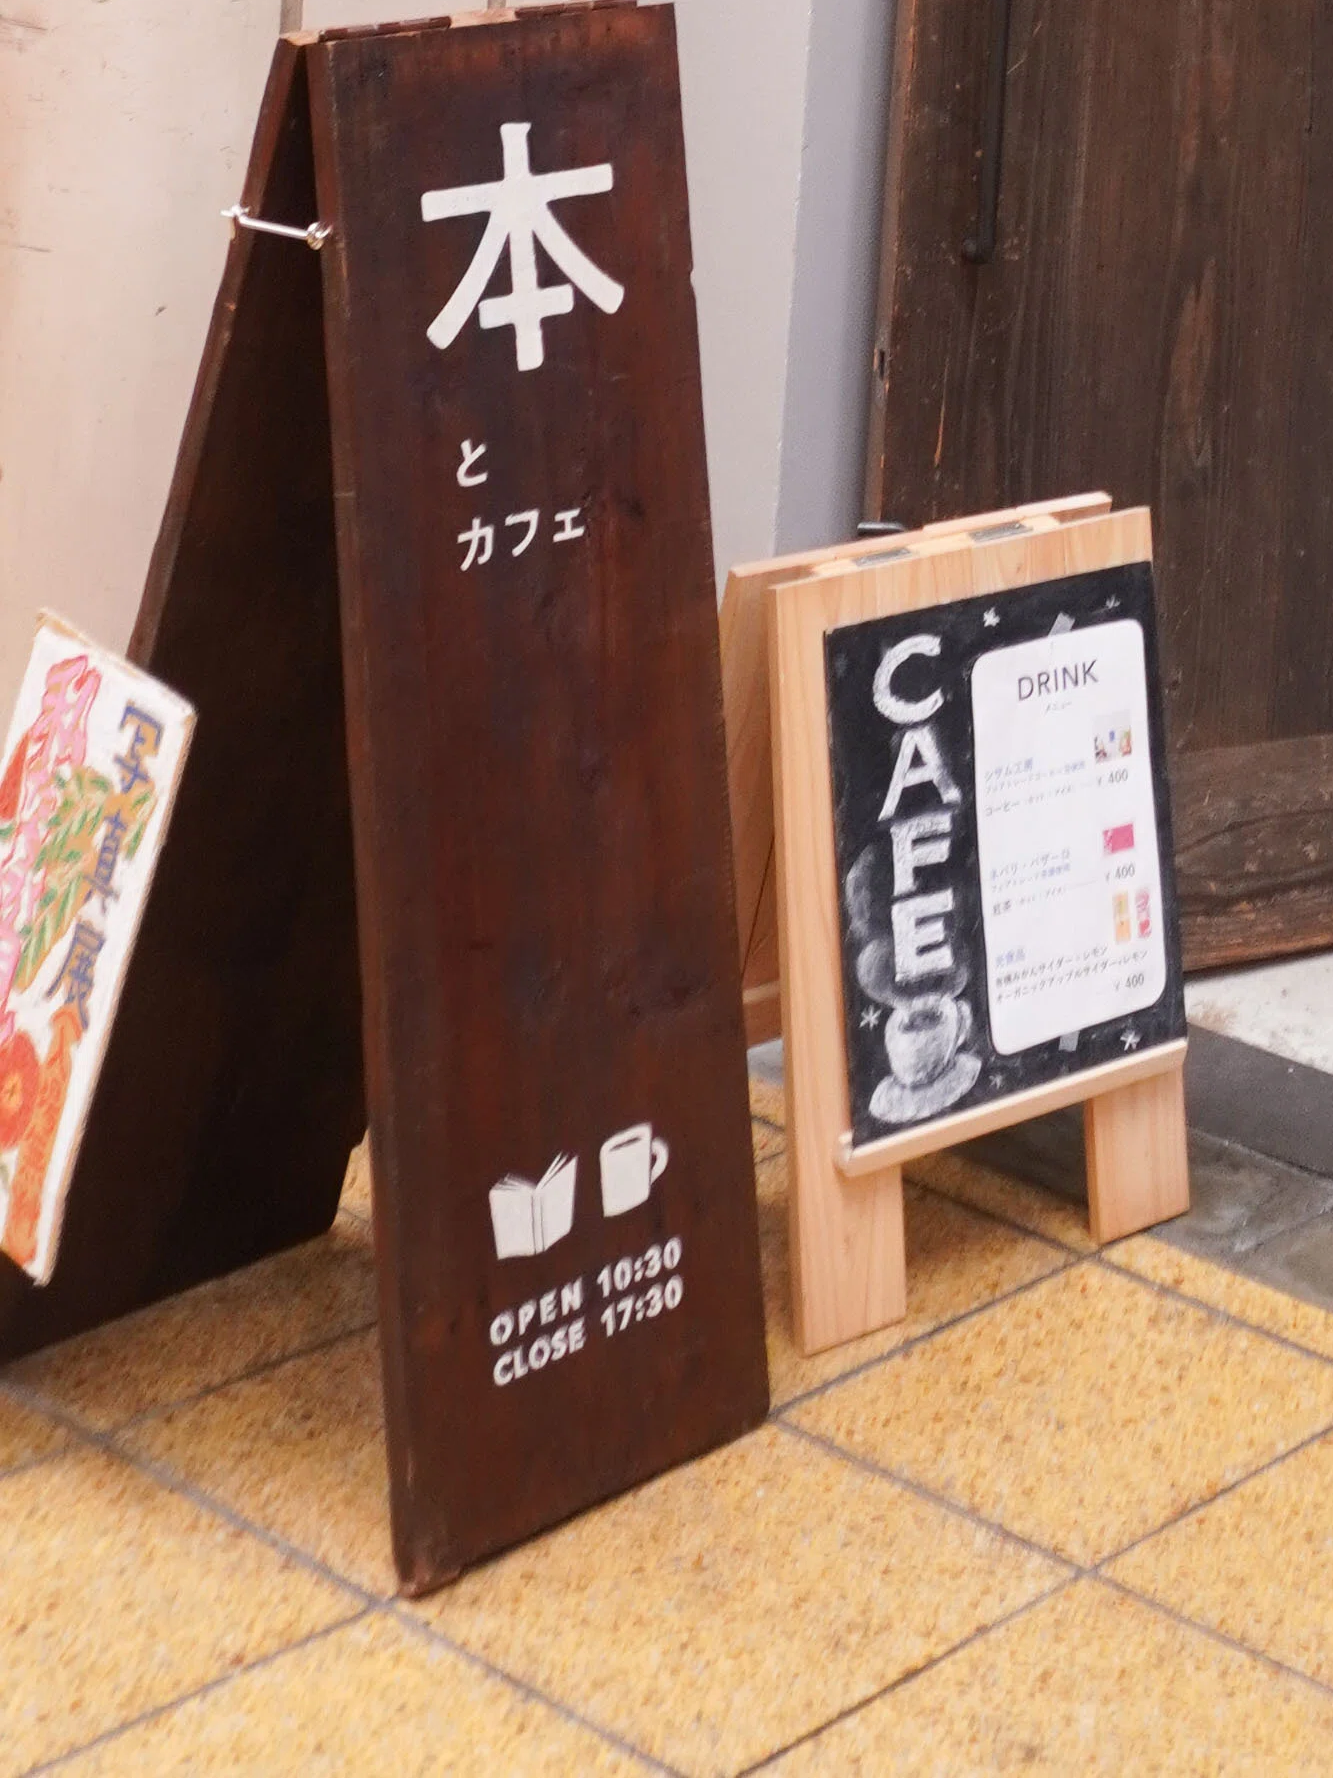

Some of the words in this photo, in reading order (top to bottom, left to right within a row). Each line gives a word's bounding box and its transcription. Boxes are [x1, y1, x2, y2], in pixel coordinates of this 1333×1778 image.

[421, 119, 625, 373] 本
[455, 436, 491, 488] と
[456, 508, 587, 573] カフェ
[1017, 659, 1099, 702] DRINK
[1108, 768, 1129, 784] 400
[872, 632, 962, 985] CAFE
[1114, 863, 1136, 880] 400
[1124, 973, 1145, 990] 400
[489, 1276, 584, 1346] OPEN
[596, 1235, 683, 1298] 10:30
[493, 1315, 587, 1387] CLOSE
[600, 1274, 684, 1338] 17:30
